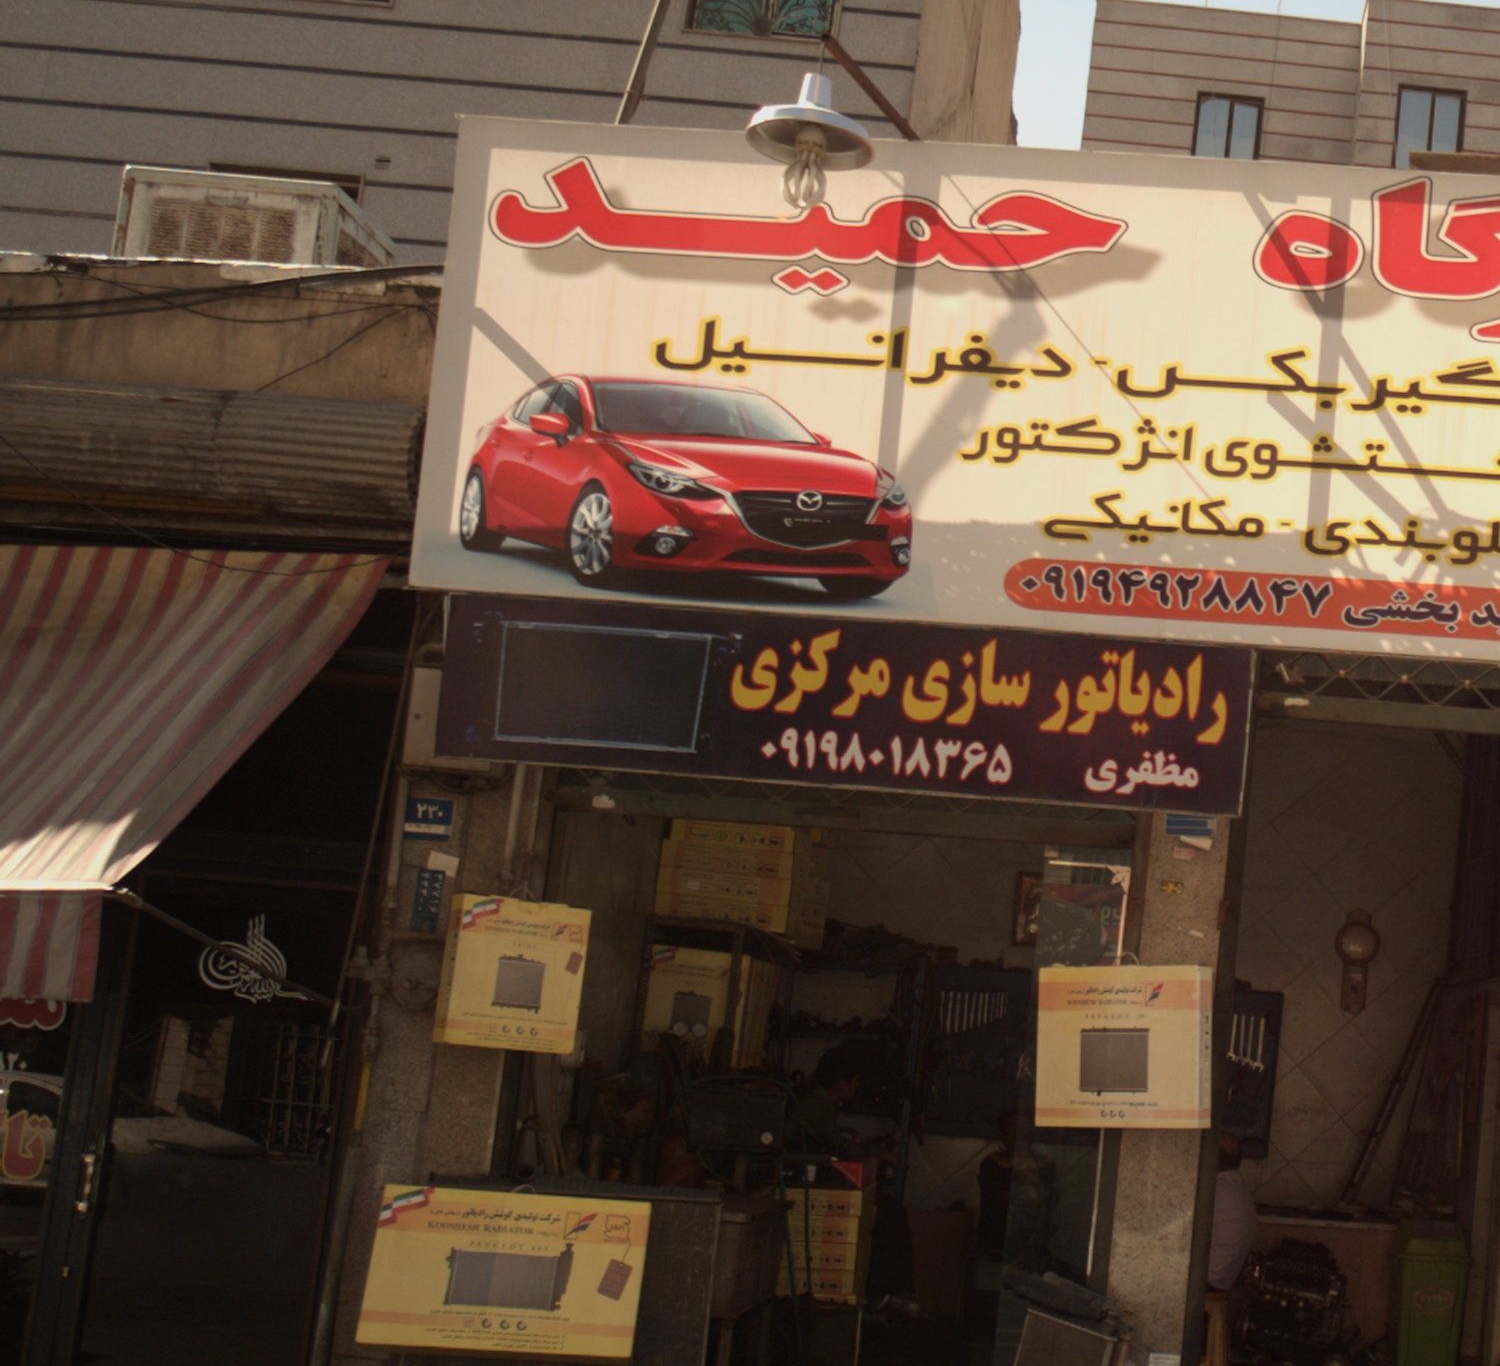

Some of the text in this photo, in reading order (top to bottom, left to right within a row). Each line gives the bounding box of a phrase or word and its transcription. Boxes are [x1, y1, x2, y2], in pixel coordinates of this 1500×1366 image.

[490, 156, 1128, 296] حمید
[652, 314, 1072, 390] دیفرانسیل
[960, 418, 1194, 471] انژکتور
[1042, 493, 1265, 542] مکانیکی
[1019, 563, 1332, 617] ۰۹۱۹۴۹۲۸۸۴۷
[1344, 589, 1459, 635] بخشی
[729, 628, 1228, 745] رادیاتور سازی مرکزی
[760, 728, 1200, 794] مظفری ۰۹۱۹۸۰۱۸۳۶۵
